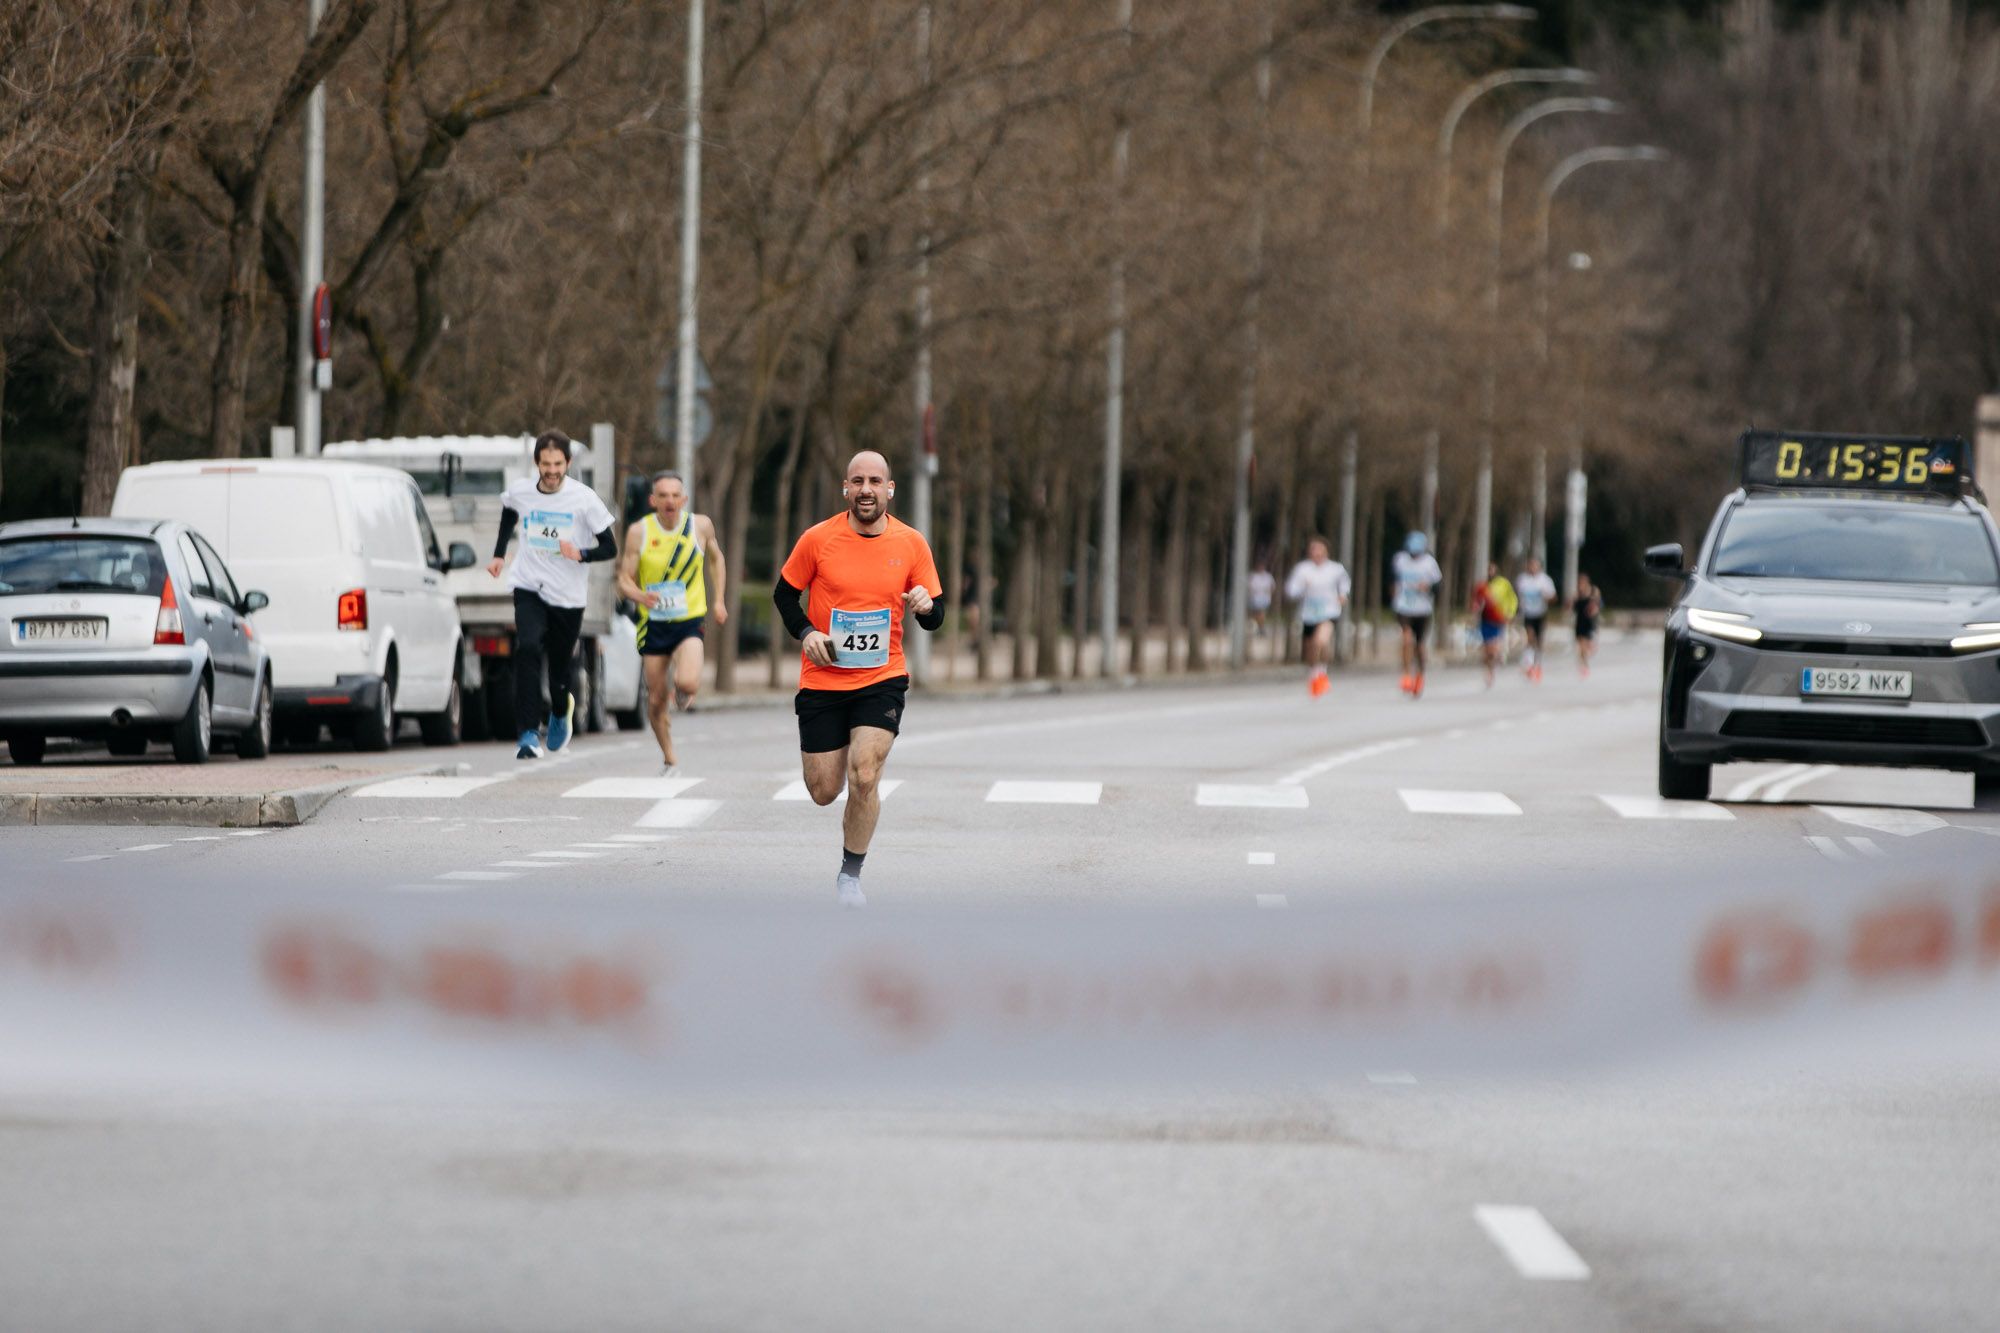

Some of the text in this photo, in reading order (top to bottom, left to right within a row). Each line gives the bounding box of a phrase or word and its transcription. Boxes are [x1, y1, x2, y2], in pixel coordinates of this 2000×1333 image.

[542, 526, 558, 538] 46
[843, 633, 879, 651] 432
[1816, 672, 1904, 691] 9592 NKK
